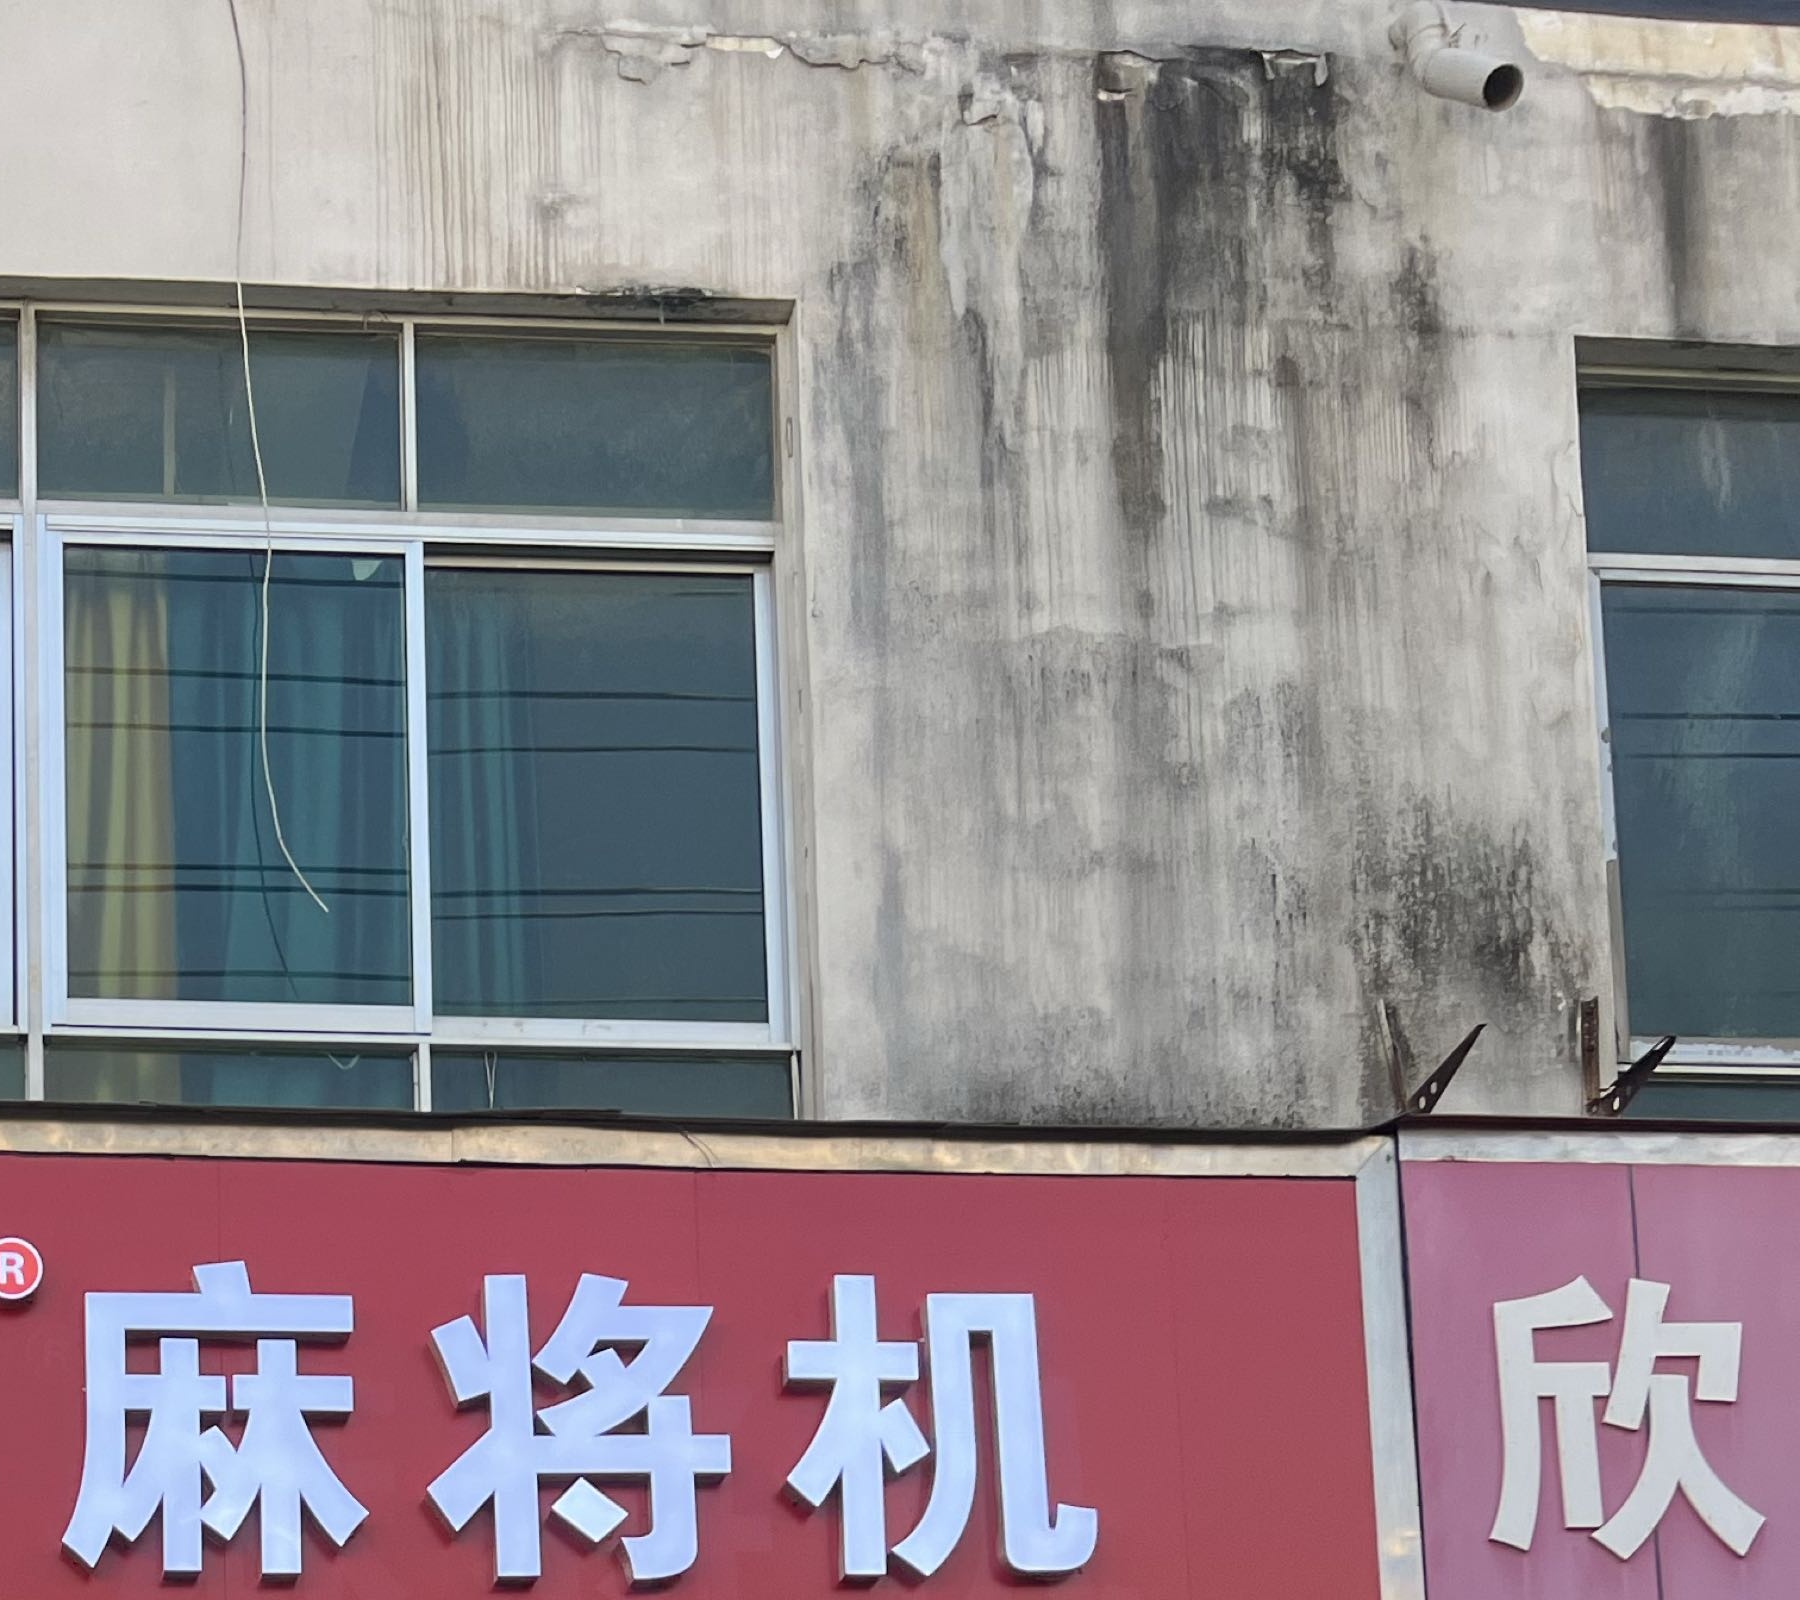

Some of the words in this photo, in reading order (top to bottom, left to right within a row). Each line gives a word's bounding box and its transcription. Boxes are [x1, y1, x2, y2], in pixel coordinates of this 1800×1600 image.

[61, 1260, 1099, 1586] 麻将机
[1489, 1275, 1766, 1561] 欣
